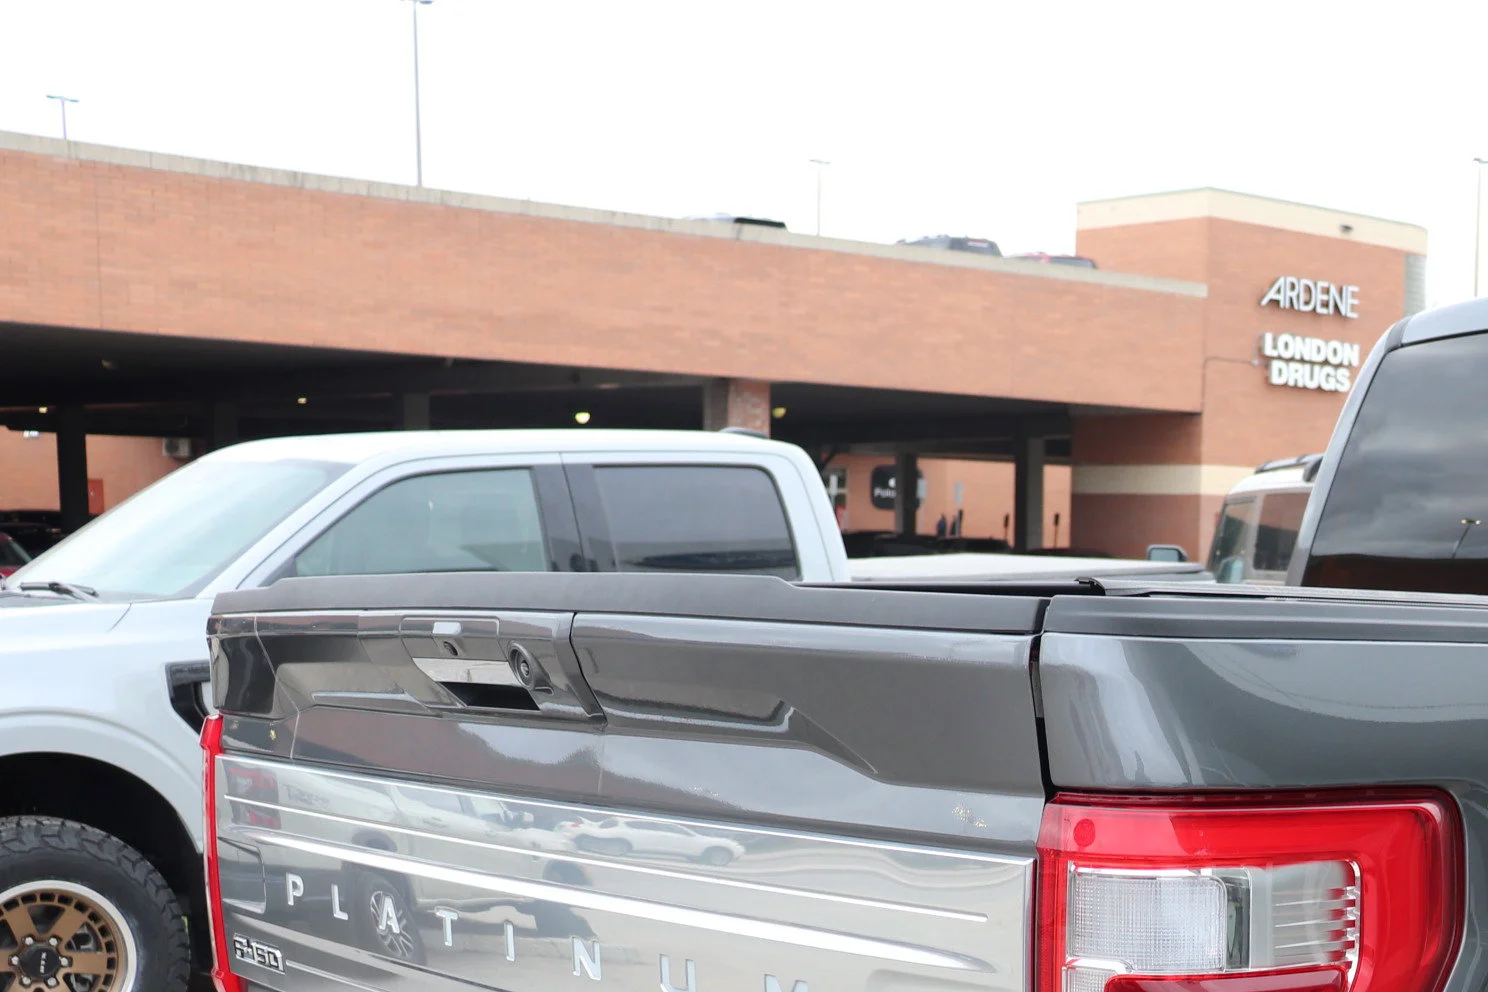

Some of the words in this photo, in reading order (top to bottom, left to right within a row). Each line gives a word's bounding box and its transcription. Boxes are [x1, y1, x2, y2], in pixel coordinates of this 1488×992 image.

[1260, 276, 1360, 319] ARDENE
[1263, 332, 1360, 367] LONDON
[1270, 360, 1351, 393] DRUGS
[233, 933, 286, 975] F-150
